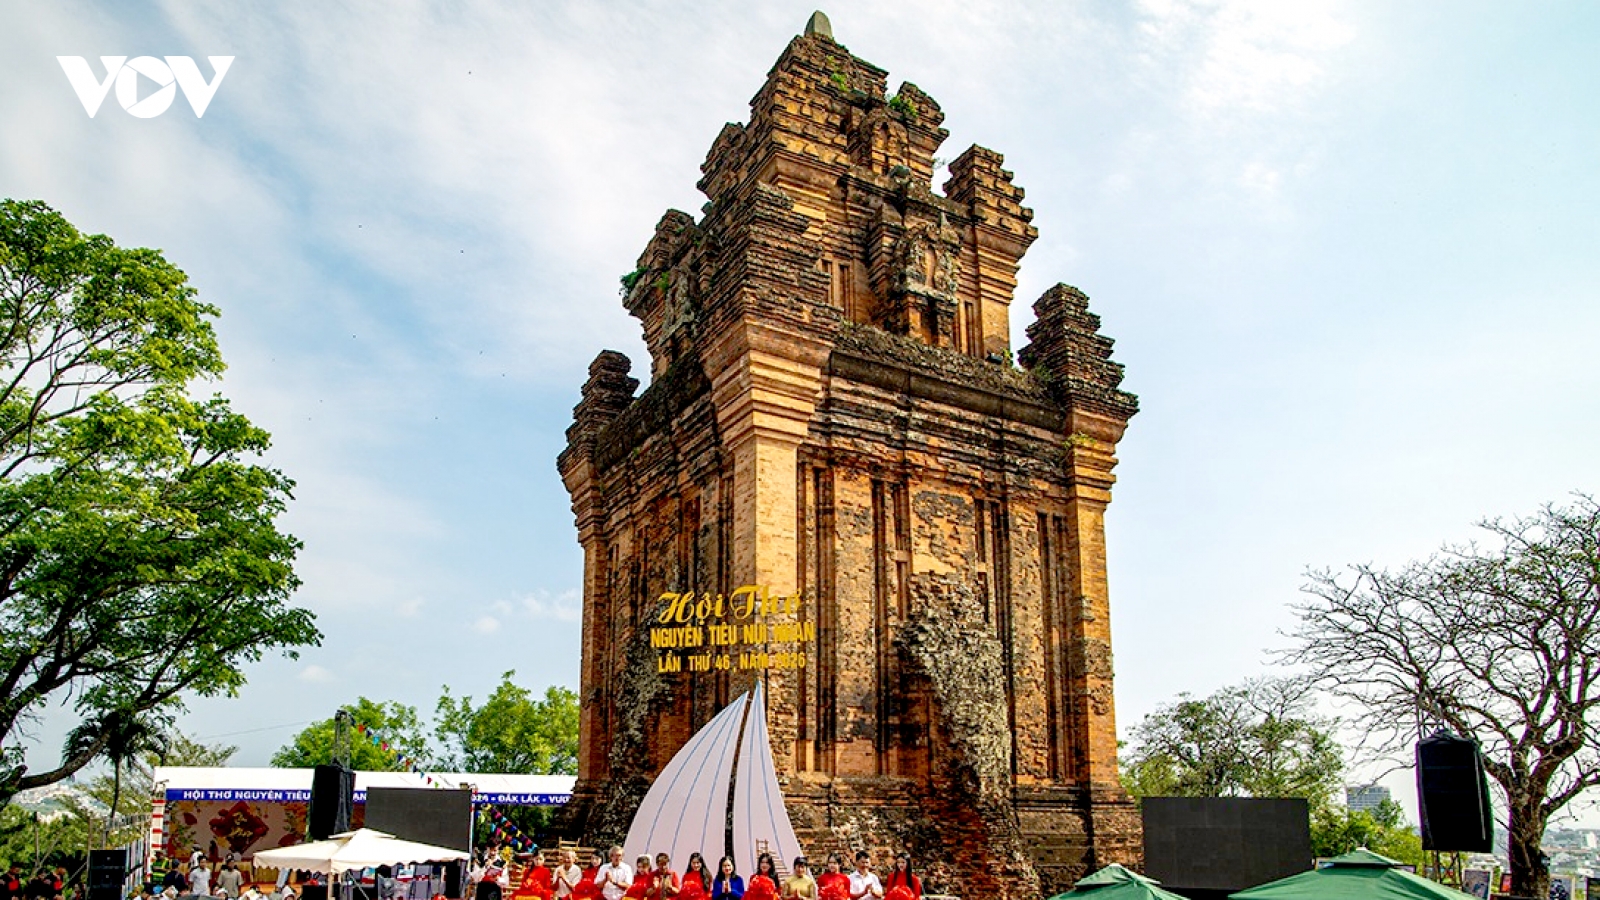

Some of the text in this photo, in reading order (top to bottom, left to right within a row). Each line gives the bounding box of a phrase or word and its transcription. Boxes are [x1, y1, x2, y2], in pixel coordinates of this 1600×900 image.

[658, 584, 802, 626] Hội Thơ
[650, 624, 703, 648] NGUYÊN
[708, 622, 737, 647] TIÊU
[658, 650, 681, 673] LẦN
[687, 650, 711, 672] THỨ
[183, 789, 311, 800] HỘI THƠ NGUYÊN TIÊU
